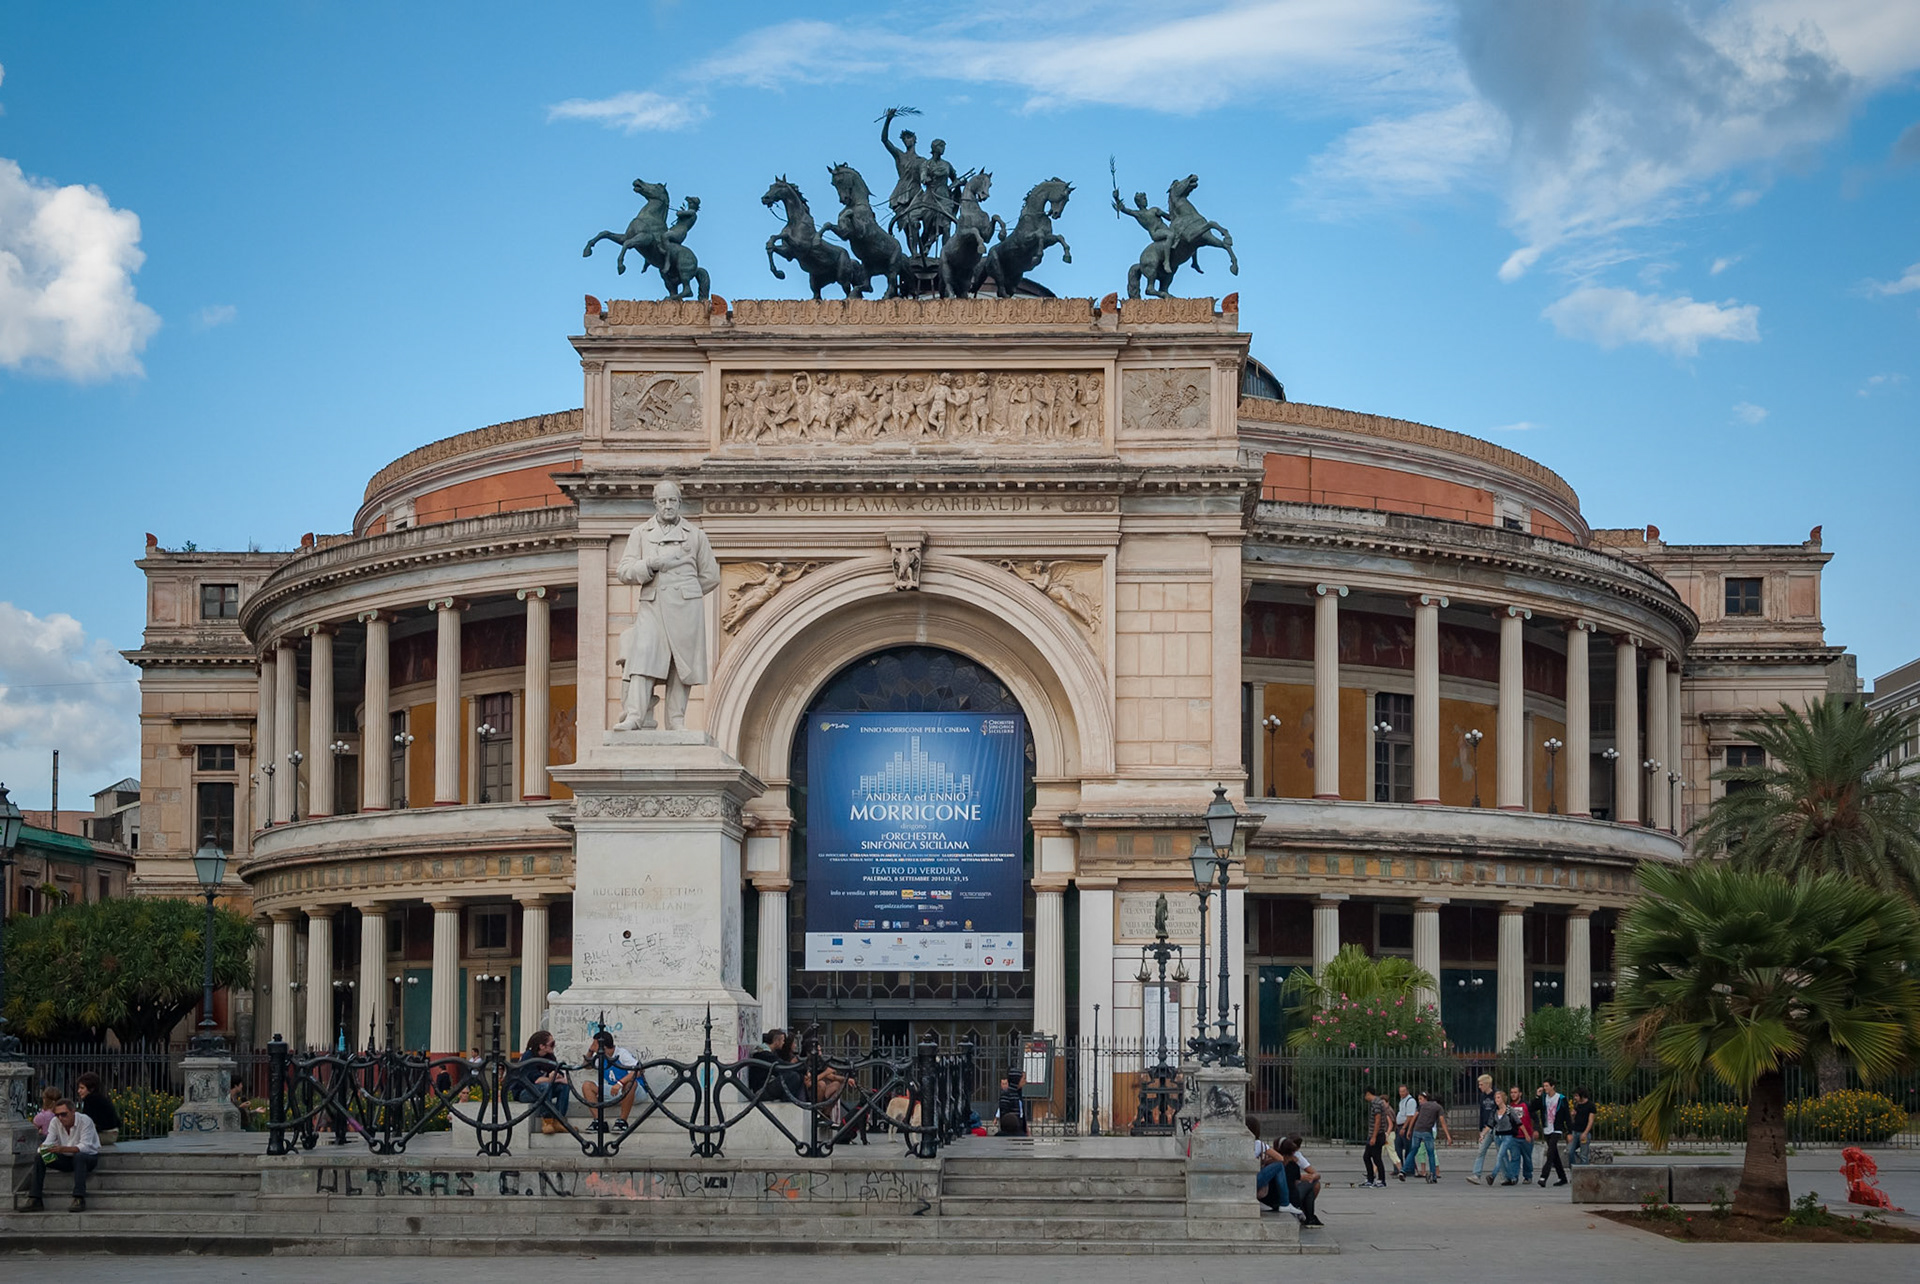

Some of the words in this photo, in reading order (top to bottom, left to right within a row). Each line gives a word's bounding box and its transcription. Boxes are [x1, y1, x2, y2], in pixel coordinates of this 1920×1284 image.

[784, 498, 901, 512] POLITEAMA
[921, 498, 1030, 511] GARIBALDI
[865, 793, 911, 802] ANDREA
[914, 793, 927, 802] ed
[930, 793, 966, 802] ENNIO
[850, 804, 981, 821] MORRICONE
[900, 823, 927, 831] dirigono
[861, 841, 917, 850] SINFONICA
[919, 841, 970, 850] SICILIANA
[870, 867, 905, 875] TEATRO
[907, 867, 917, 875] DI
[919, 867, 962, 875] VERDURA
[592, 888, 645, 897] RUGGIERO
[317, 1168, 476, 1197] ULTRAS
